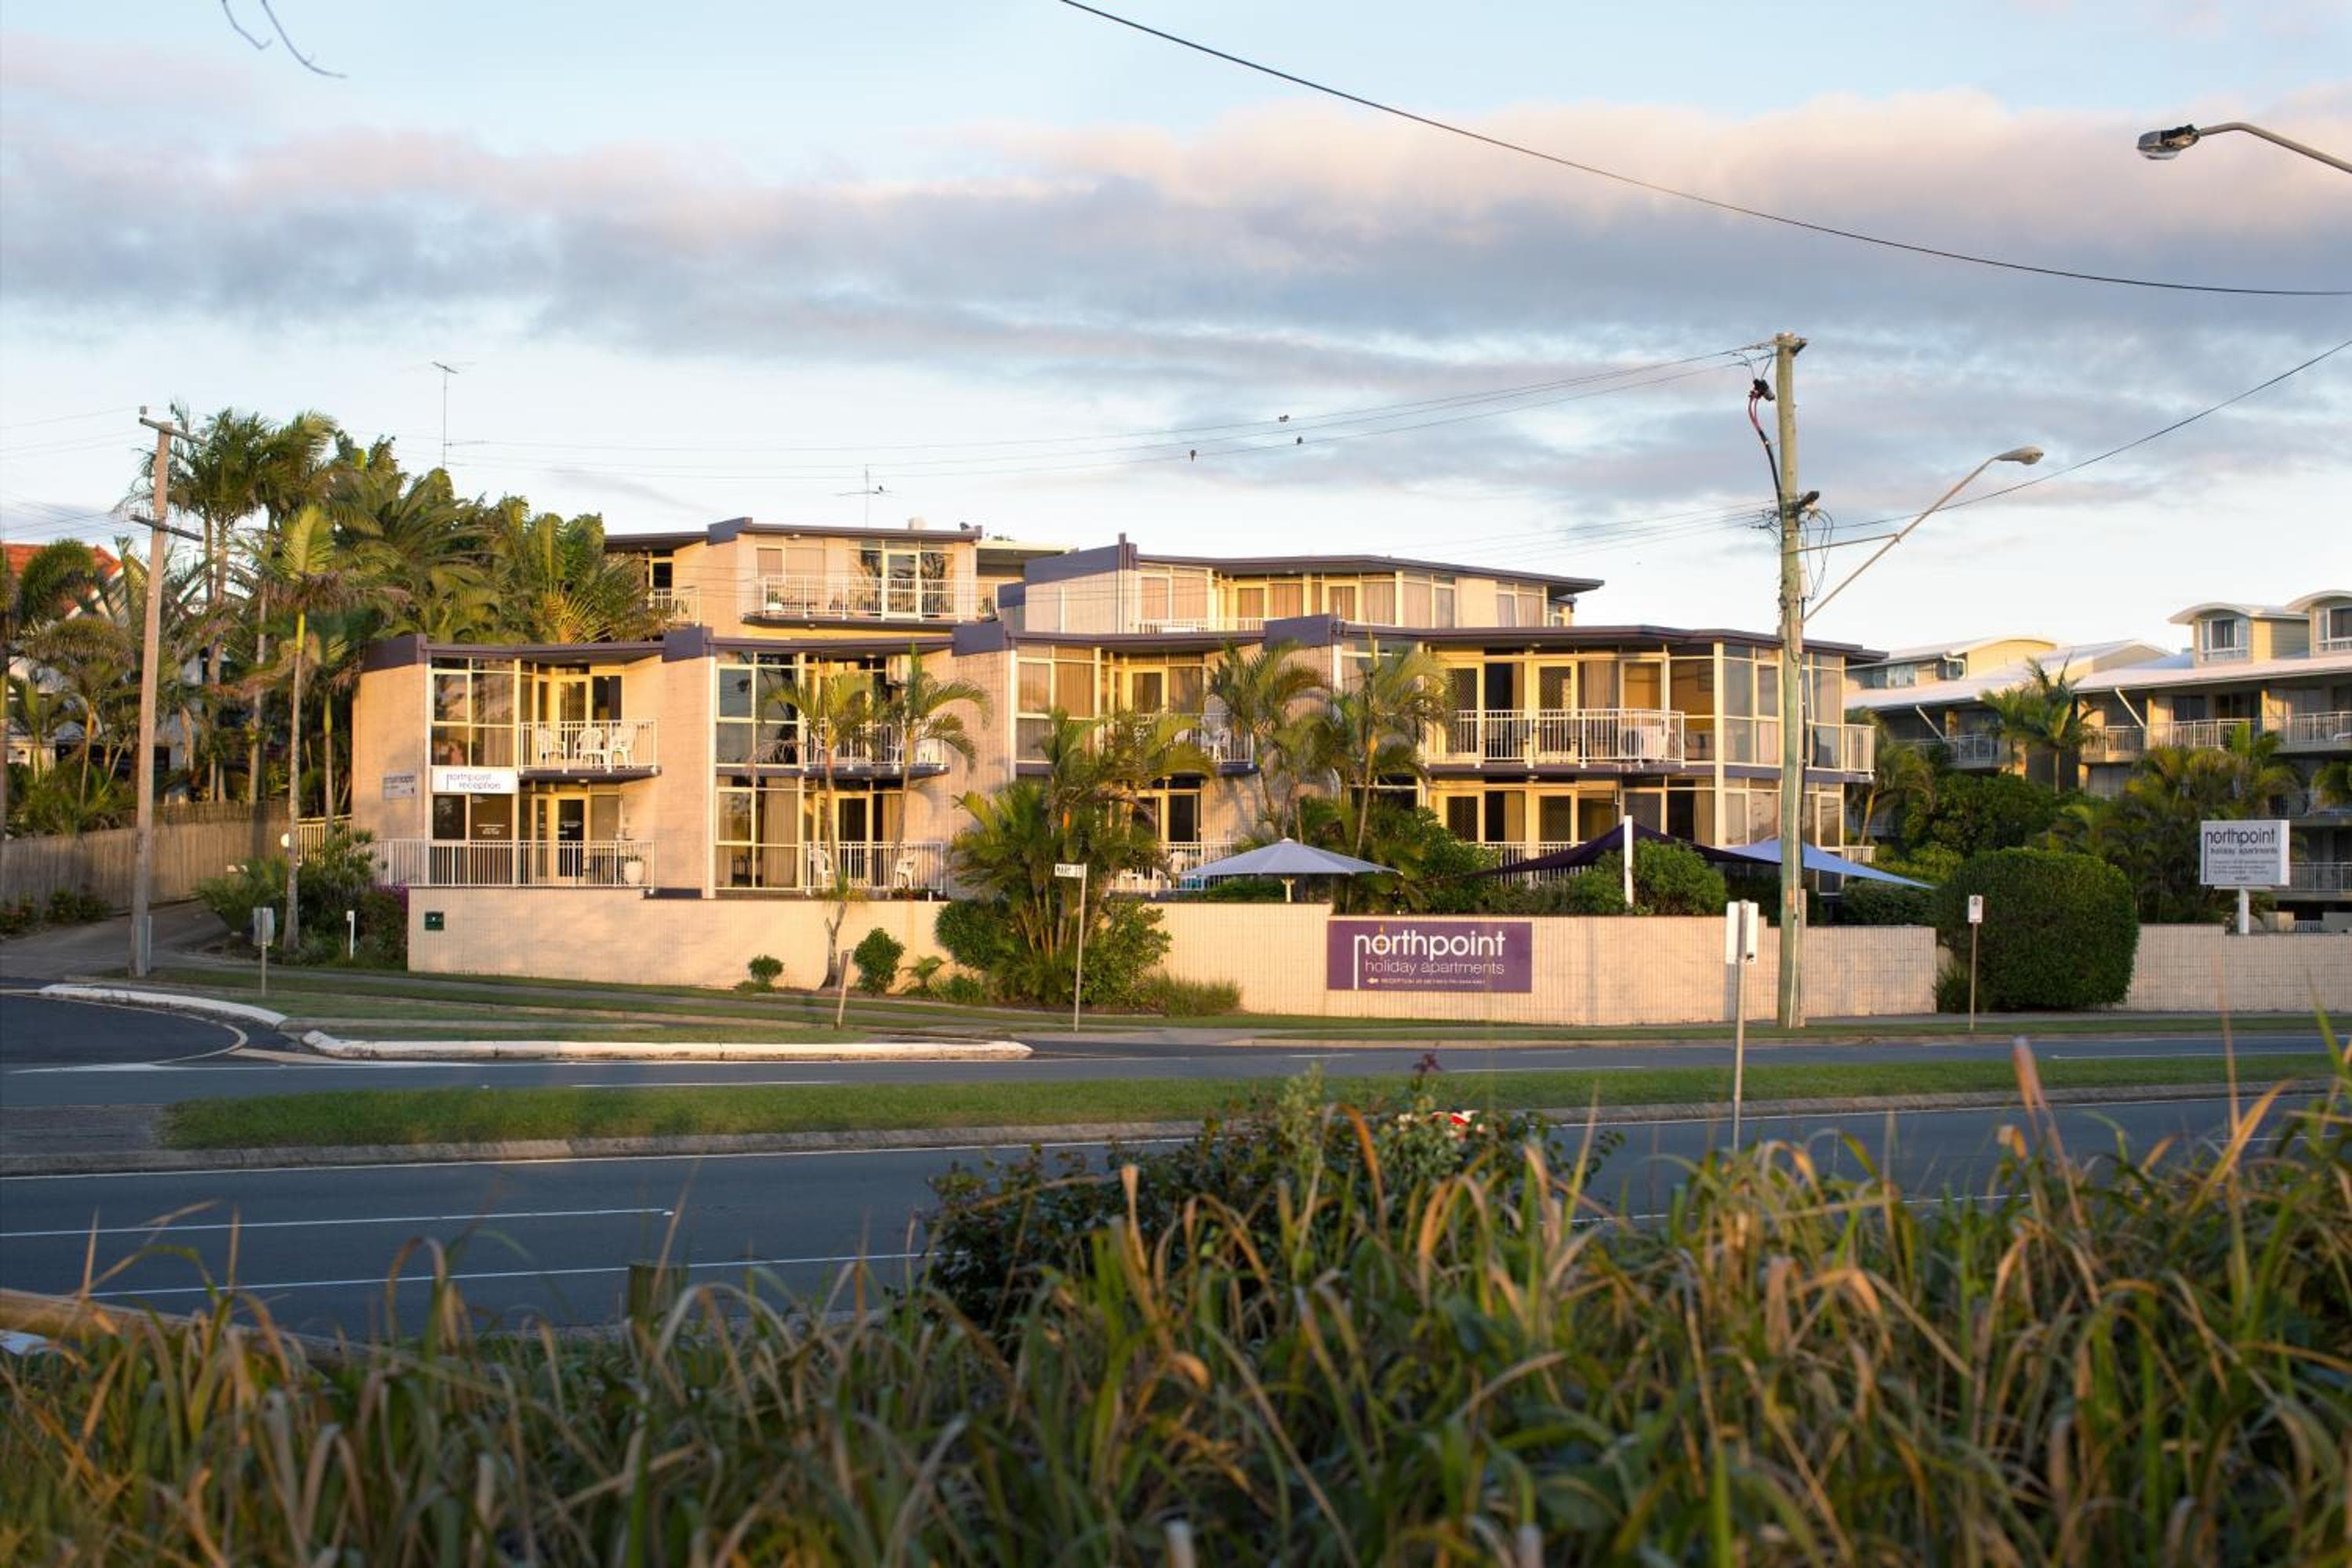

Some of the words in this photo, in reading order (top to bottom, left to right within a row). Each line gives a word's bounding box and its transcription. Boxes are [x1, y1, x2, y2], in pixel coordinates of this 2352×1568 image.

[458, 781, 501, 790] reception
[1354, 930, 1506, 961] northpoint
[1365, 960, 1416, 975] holiday
[1421, 961, 1505, 975] apartments
